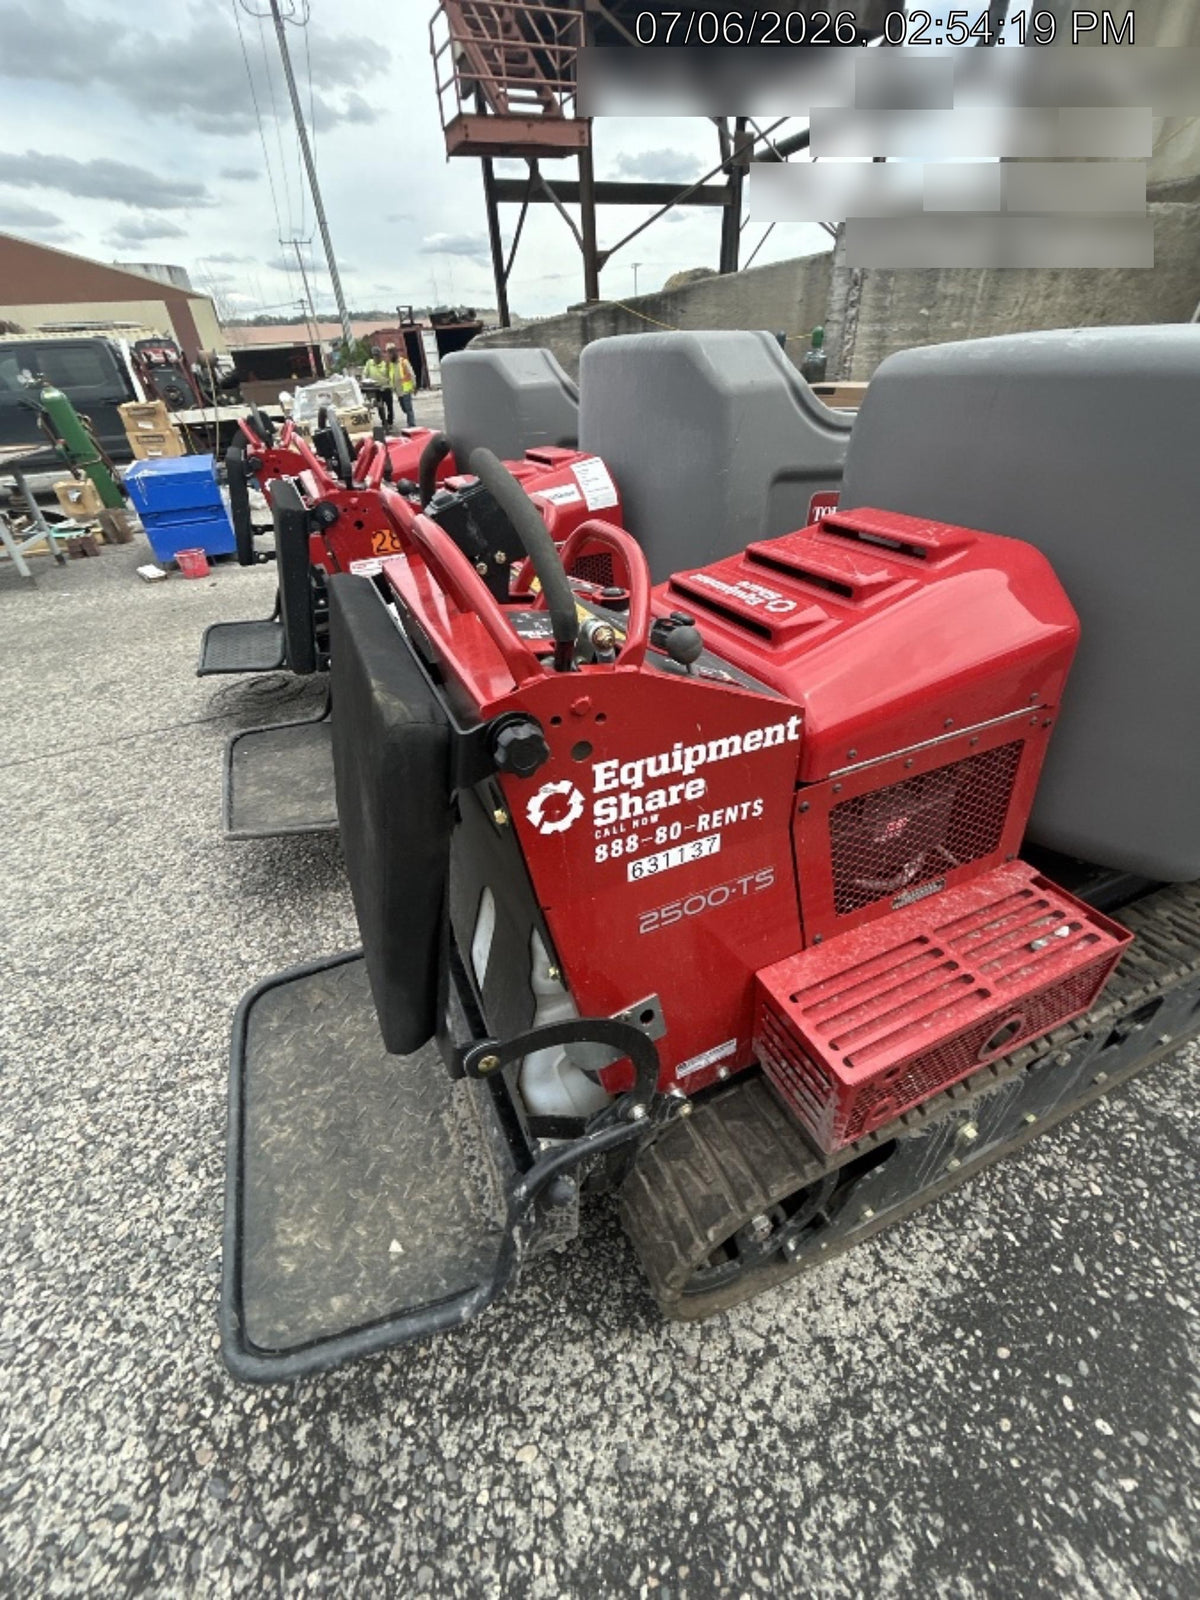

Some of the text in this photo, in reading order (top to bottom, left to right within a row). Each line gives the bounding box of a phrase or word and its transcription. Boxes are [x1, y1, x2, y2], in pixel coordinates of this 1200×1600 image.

[351, 413, 370, 425] 3M
[592, 715, 802, 793] Equipment
[593, 777, 706, 826] Share
[594, 822, 626, 840] CALL
[595, 798, 764, 863] 888-80-RENTS
[631, 836, 718, 880] 631137
